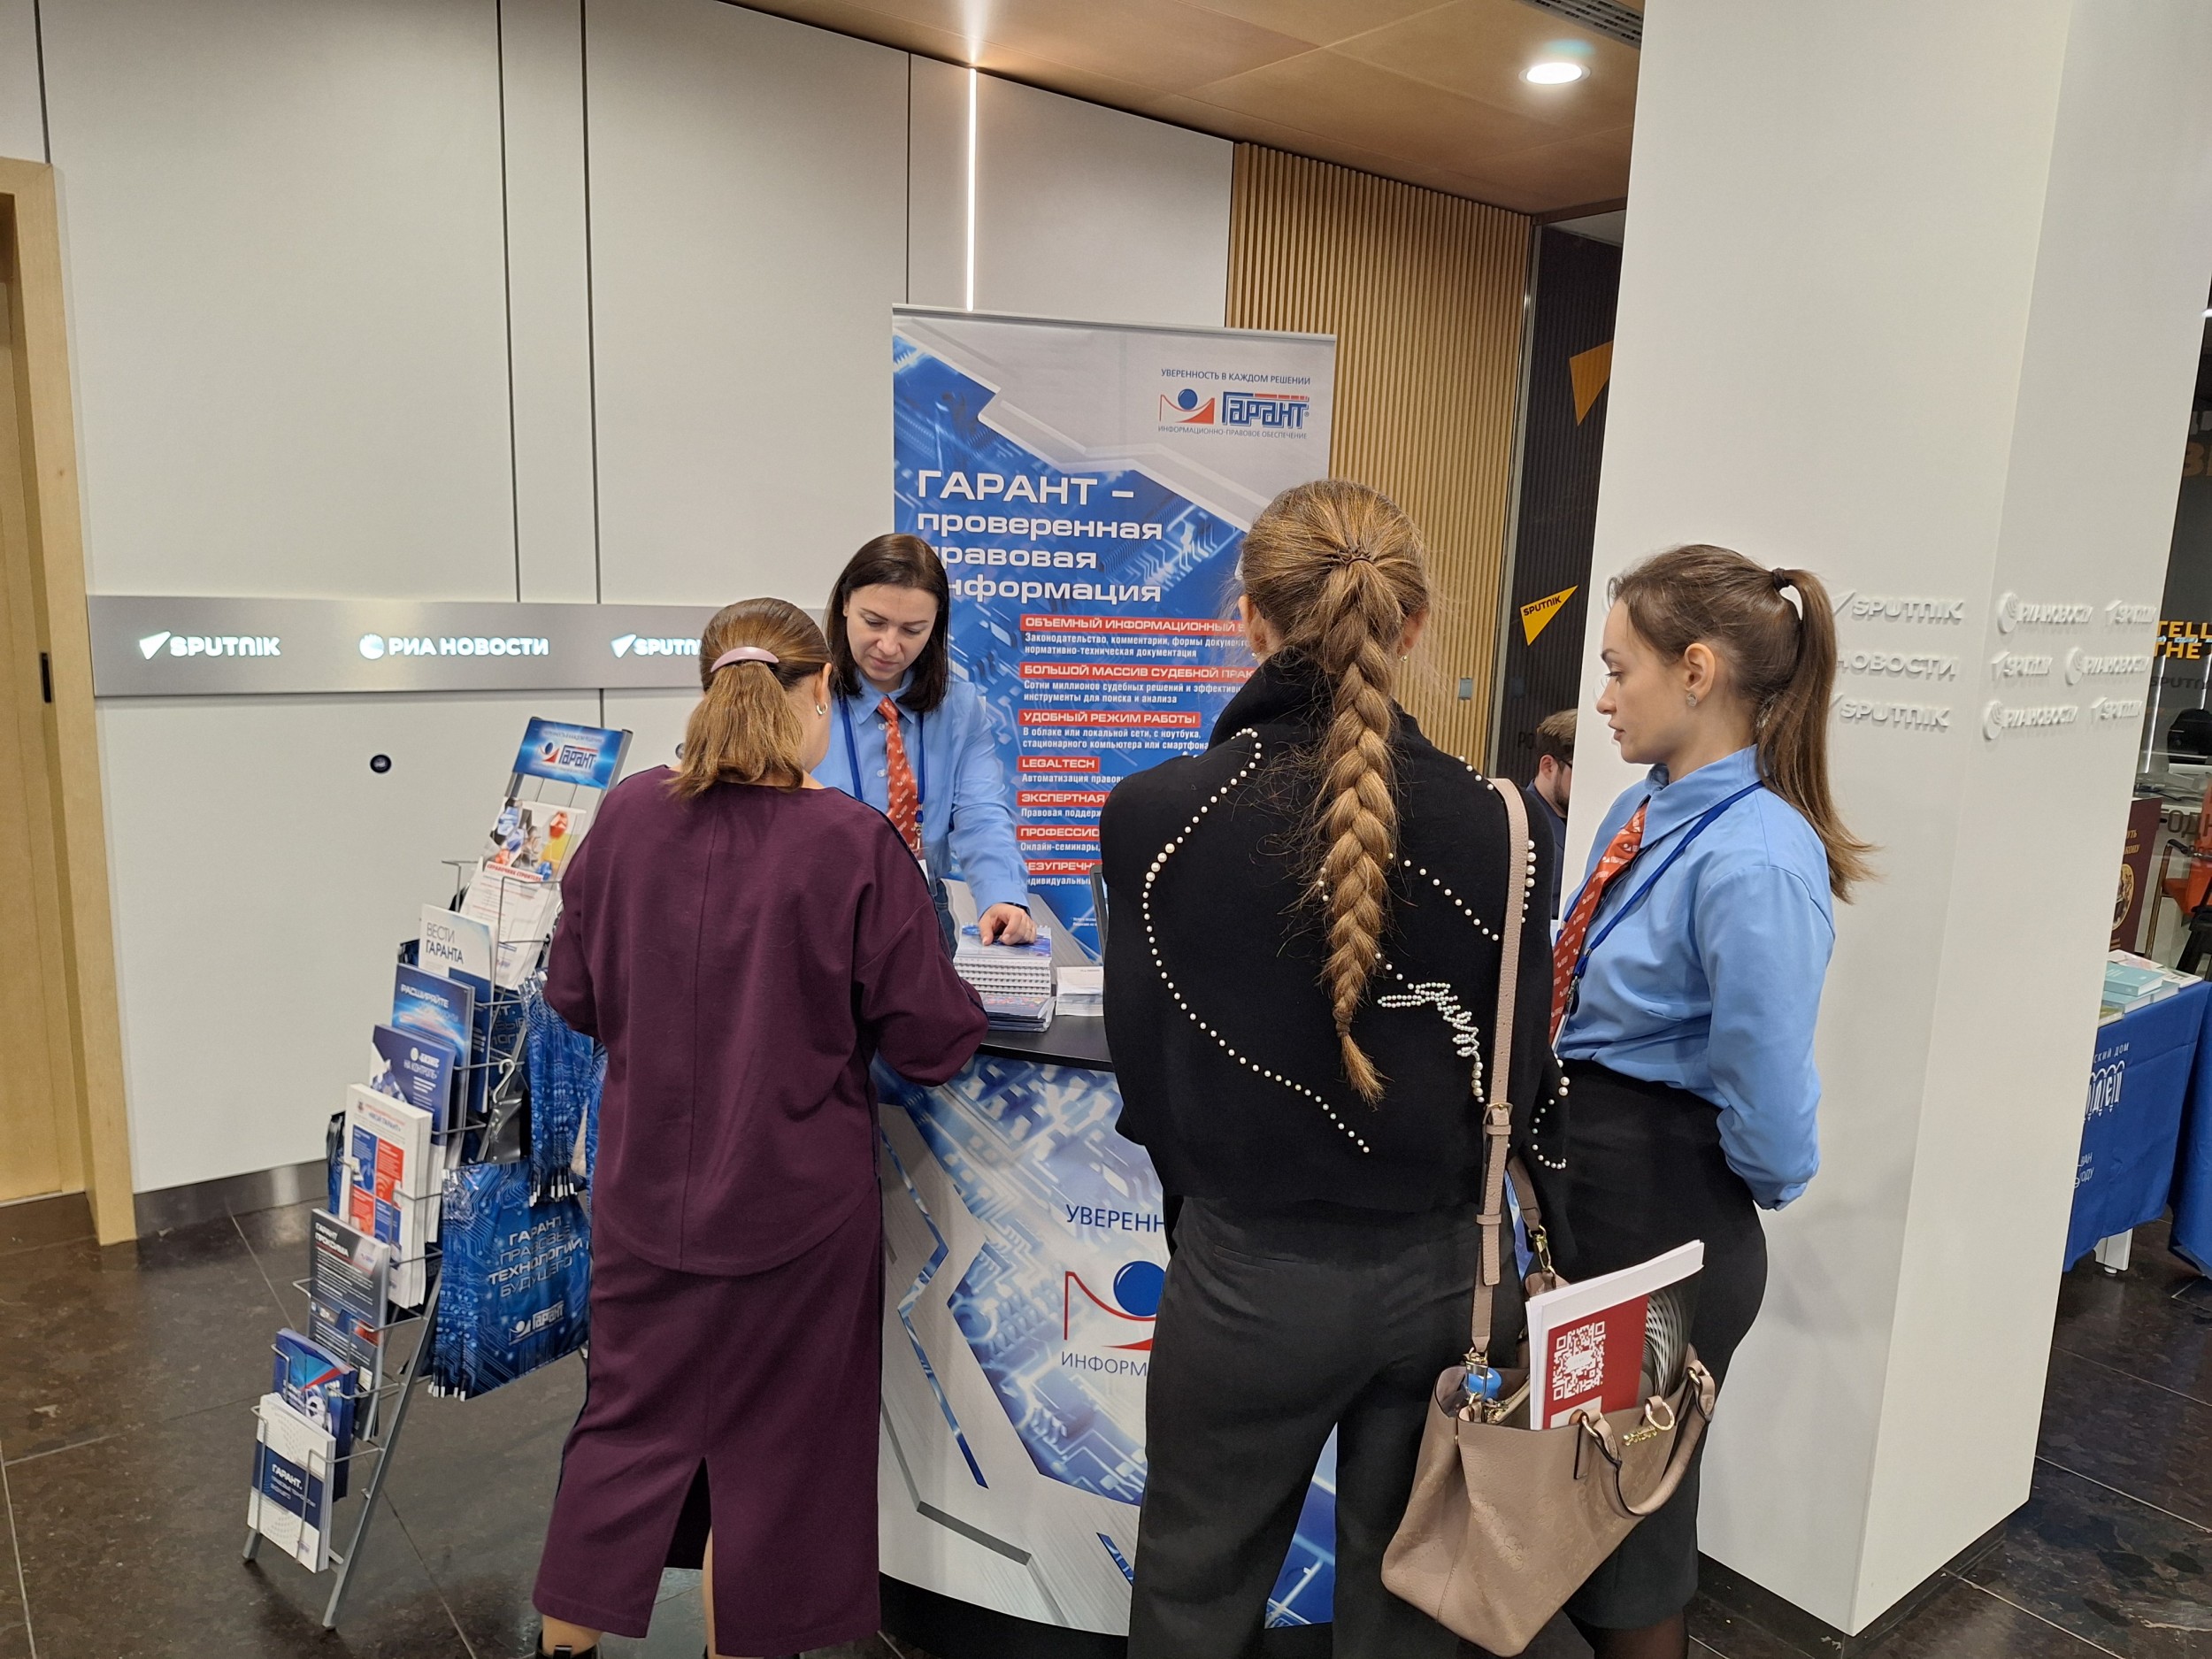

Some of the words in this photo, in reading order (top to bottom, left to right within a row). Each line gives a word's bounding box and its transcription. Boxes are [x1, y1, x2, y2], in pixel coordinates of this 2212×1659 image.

[1161, 369, 1219, 380] УВЕРЕННОСТЬ
[1228, 373, 1268, 383] КАЖДОМ
[1271, 376, 1310, 385] РЕШЕНИИ
[1158, 426, 1261, 437] ИНФОРМАЦИОННО-ПРАВОВОЕ
[918, 470, 1098, 506] ГАРАНТ
[918, 512, 1163, 541] проверенная
[1524, 595, 1562, 616] SPUTNIK
[1853, 597, 1964, 621] SPUTNIK
[1025, 617, 1102, 629] ОБЪЕМНЫЙ
[1105, 618, 1234, 633] ИНФОРМАЦИОННЫЙ
[170, 636, 281, 657] SPUTNIK
[388, 637, 437, 657] РИА
[440, 637, 549, 657] НОВОСТИ
[1025, 633, 1109, 644] Законодательство,
[1111, 636, 1170, 647] комментарии,
[1171, 636, 1202, 648] формы
[1025, 646, 1134, 657] нормативно-техническая
[1136, 649, 1197, 659] документация
[1024, 664, 1088, 677] БОЛЬШОЙ
[1092, 667, 1148, 677] МАССИВ
[1151, 667, 1218, 679] СУДЕБНОЙ
[1024, 680, 1050, 690] Сотни
[1052, 682, 1100, 691] миллионов
[1102, 682, 1144, 693] судебных
[1146, 682, 1184, 694] решений
[1024, 693, 1081, 703] инструменты
[1083, 695, 1100, 704] для
[1102, 695, 1132, 703] поиска
[1024, 711, 1087, 724] УДОБНЫЙ
[1091, 713, 1141, 724] РЕЖИМ
[1144, 714, 1195, 724] РАБОТЫ
[1840, 700, 1950, 726] SPUTNIK
[1023, 727, 1028, 736] В
[1031, 727, 1062, 737] облаке
[1083, 728, 1128, 739] локальной
[1131, 731, 1151, 740] сети,
[1161, 730, 1201, 741] ноутбука,
[1023, 740, 1087, 750] стационарного
[1090, 741, 1141, 751] компьютера
[1162, 740, 1209, 751] смартфона
[1022, 759, 1094, 769] LEGALTECH
[1022, 774, 1088, 784] Автоматизация
[1091, 775, 1123, 784] правов
[1021, 794, 1105, 803] ЭКСПЕРТНАЯ
[1021, 808, 1062, 818] Правовая
[1020, 841, 1101, 853] Онлайн-семинары,
[1025, 862, 1094, 872] ЕЗУПРЕЧН
[426, 922, 455, 943] ВЕСТИ
[426, 940, 464, 964] ГАРАНТА
[401, 984, 449, 1009] РАСШИРЯЙТЕ
[2114, 1042, 2129, 1057] ДОМ
[1062, 1351, 1147, 1376] ИНФОРМ
[272, 1463, 303, 1490] ГАРАНТ.
